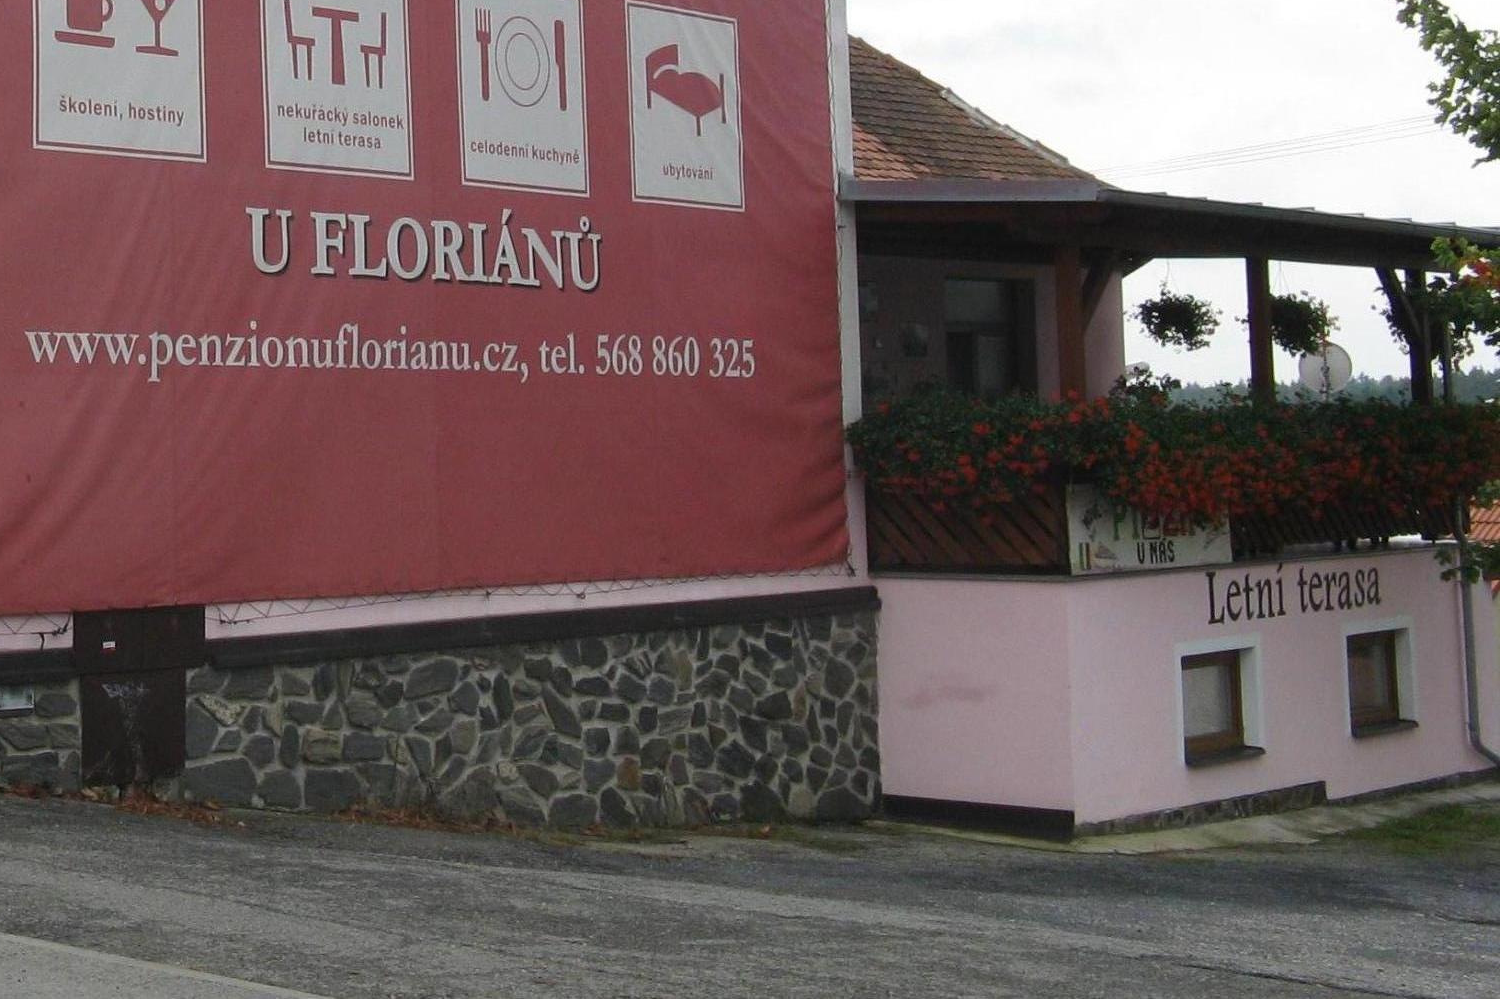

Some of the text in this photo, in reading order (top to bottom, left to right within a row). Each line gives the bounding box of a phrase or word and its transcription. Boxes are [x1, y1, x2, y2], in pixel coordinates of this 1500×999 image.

[59, 95, 185, 126] školení, hostiny
[277, 103, 405, 130] nekuřácký salonek
[303, 127, 381, 149] letní terasa
[470, 140, 580, 165] celodenní kuchyně
[662, 163, 713, 180] ubytování
[245, 207, 602, 293] U FLORIÁNŮ
[24, 320, 756, 384] www.penzionuflorianu.cz, tel. 568 860 325
[1137, 542, 1146, 564] U
[1205, 563, 1382, 625] Letní terasa
